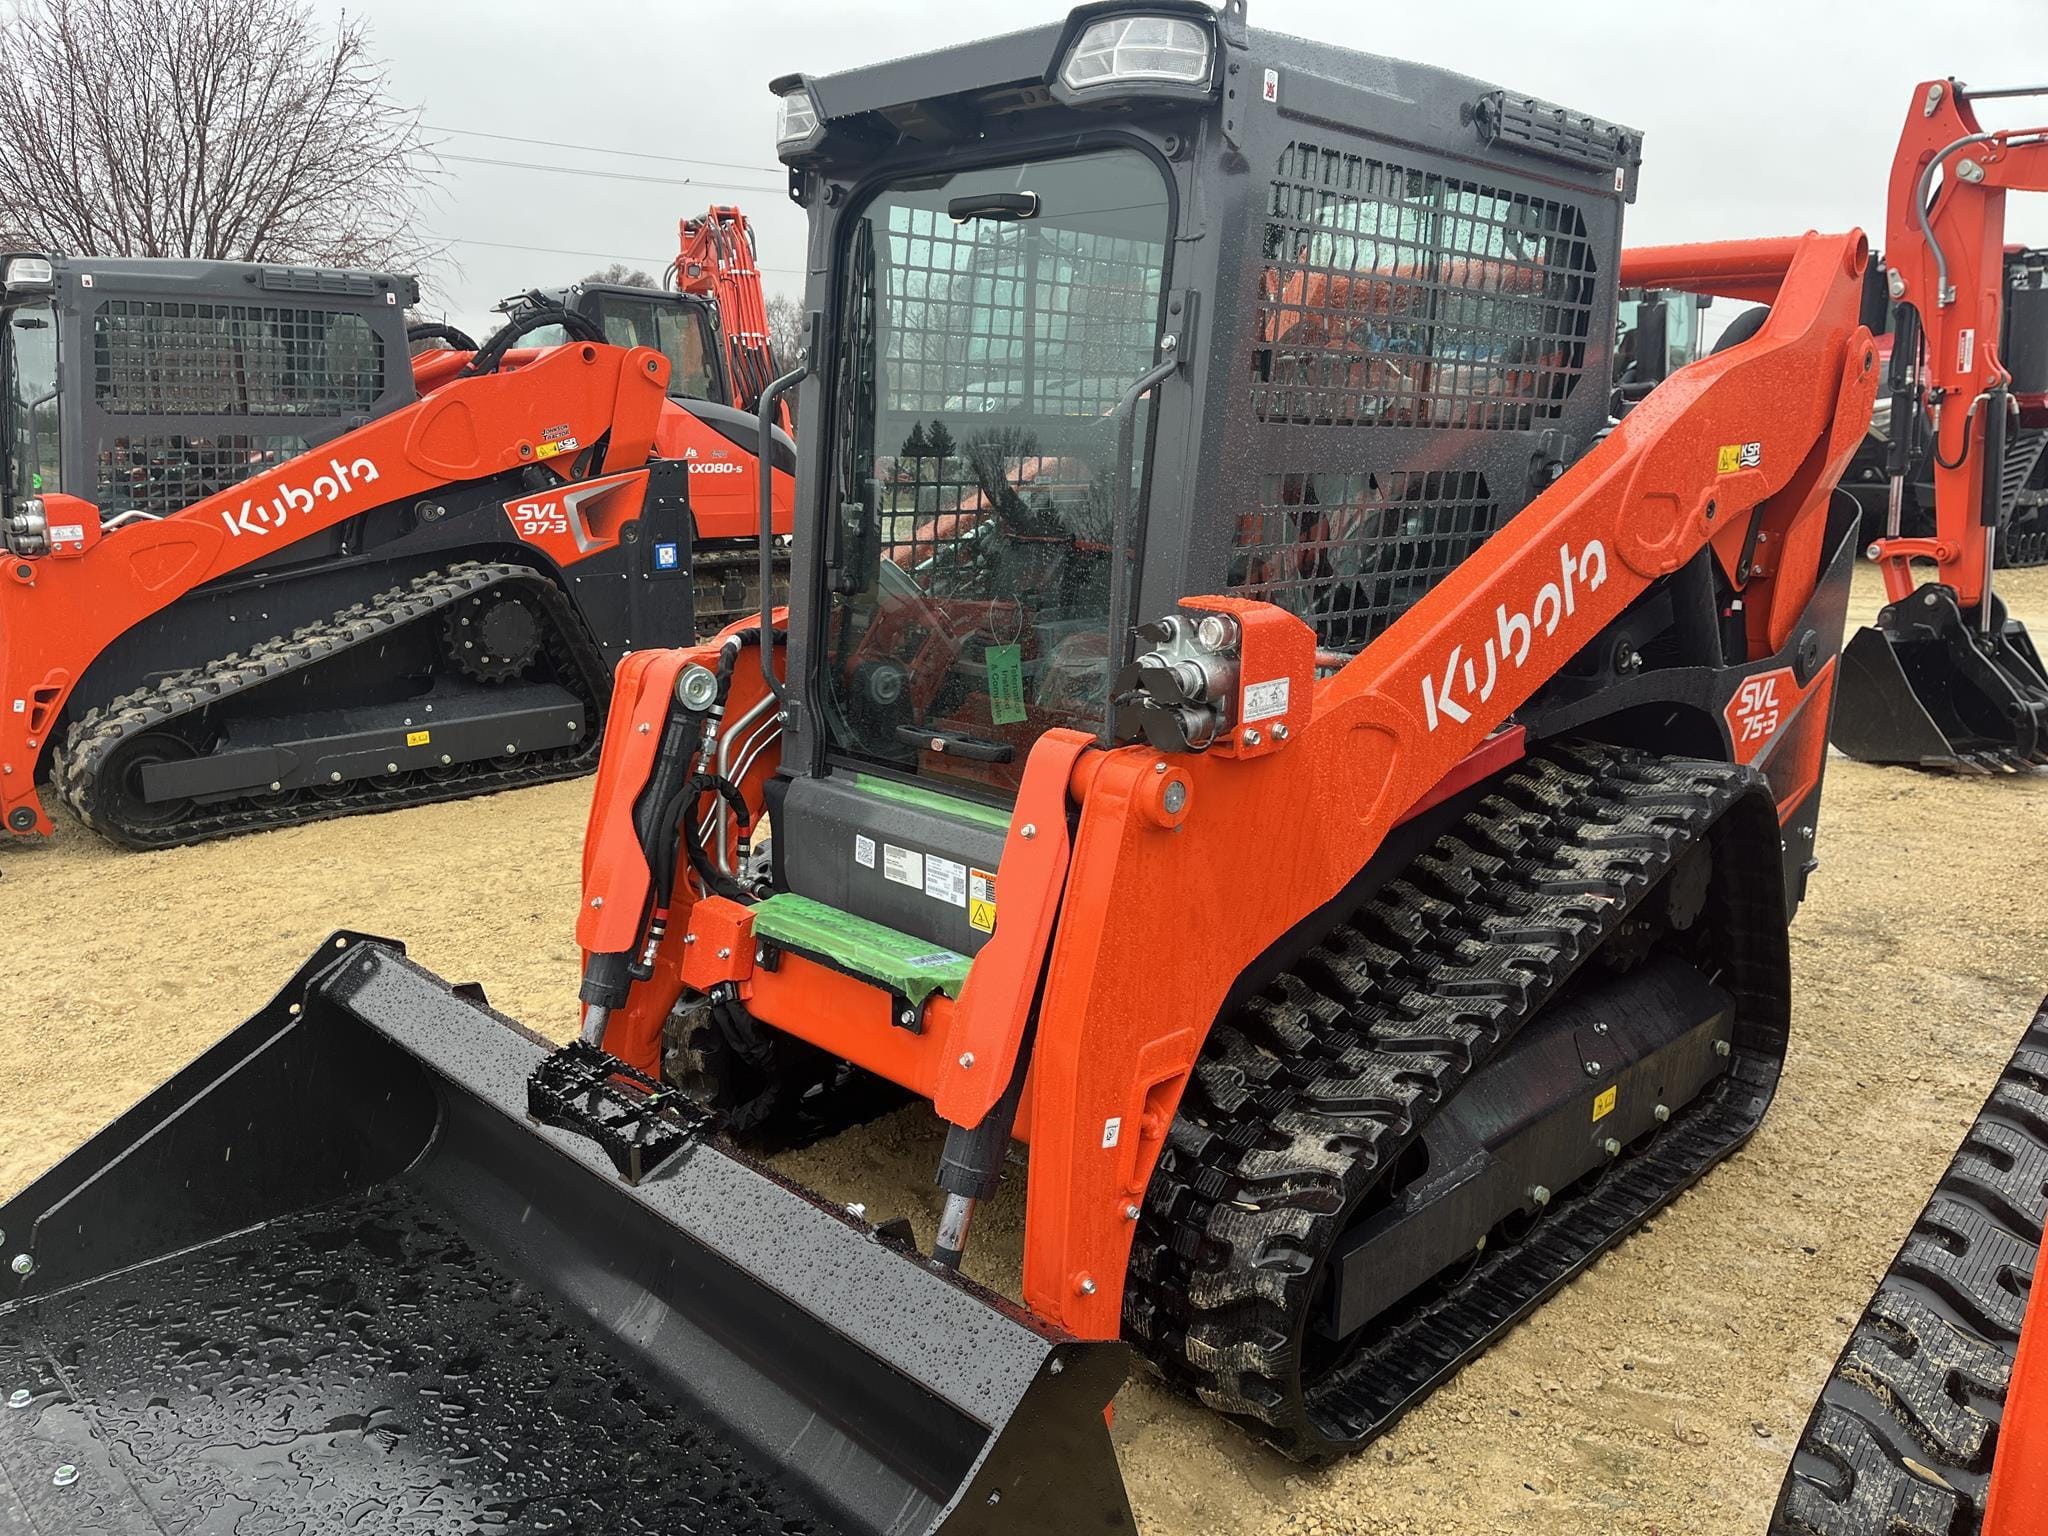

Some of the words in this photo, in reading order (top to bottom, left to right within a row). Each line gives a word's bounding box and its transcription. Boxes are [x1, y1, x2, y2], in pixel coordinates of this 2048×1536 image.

[1741, 442, 1761, 457] KSR
[220, 458, 380, 537] Kubota
[514, 502, 565, 521] SVL
[523, 520, 568, 535] 97-3
[1420, 539, 1608, 732] Kubota
[1001, 670, 1012, 710] Installed
[1010, 664, 1022, 714] Telematics
[1736, 678, 1779, 717] SVL
[1741, 709, 1779, 742] 75-3
